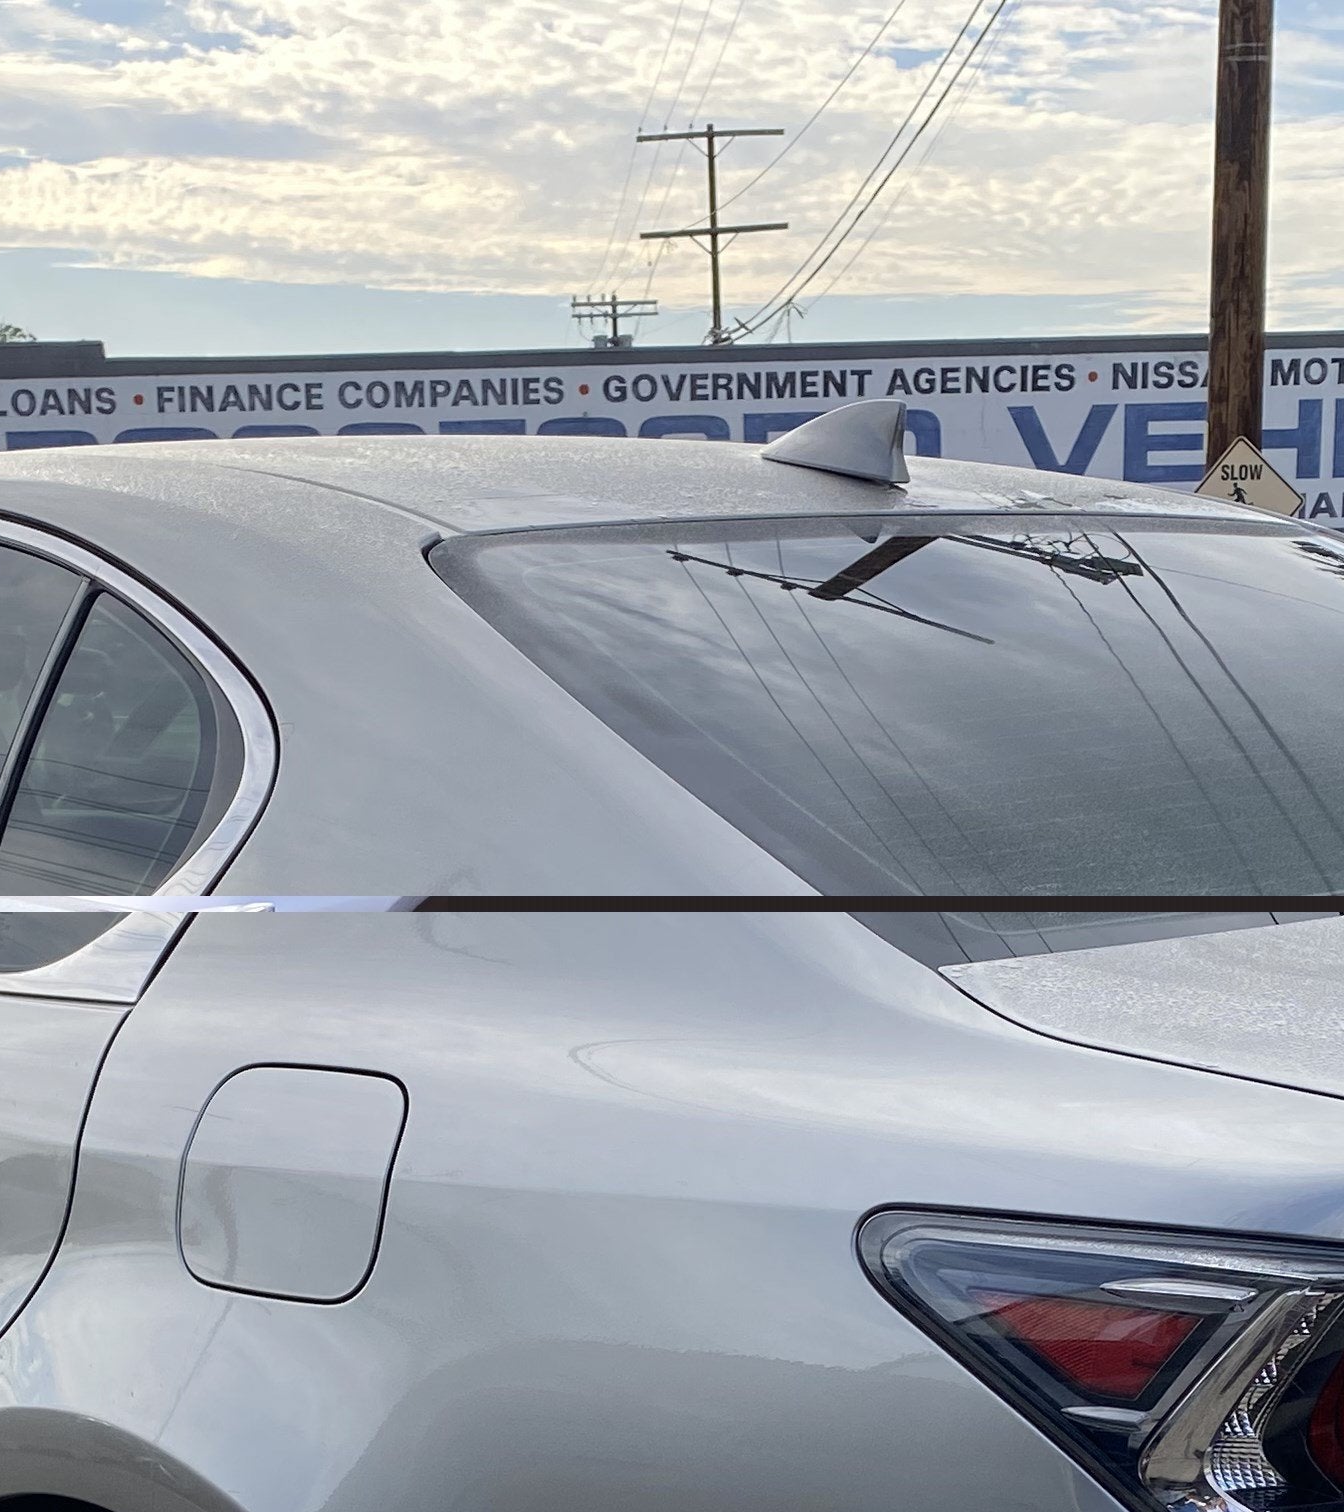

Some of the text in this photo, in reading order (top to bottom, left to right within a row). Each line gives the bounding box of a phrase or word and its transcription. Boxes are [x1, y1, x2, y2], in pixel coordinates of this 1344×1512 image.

[157, 375, 565, 413] FINANCE COMPANIES
[603, 363, 1076, 403] GOVERNMENT AGENCIES
[1221, 464, 1263, 481] SLOW
